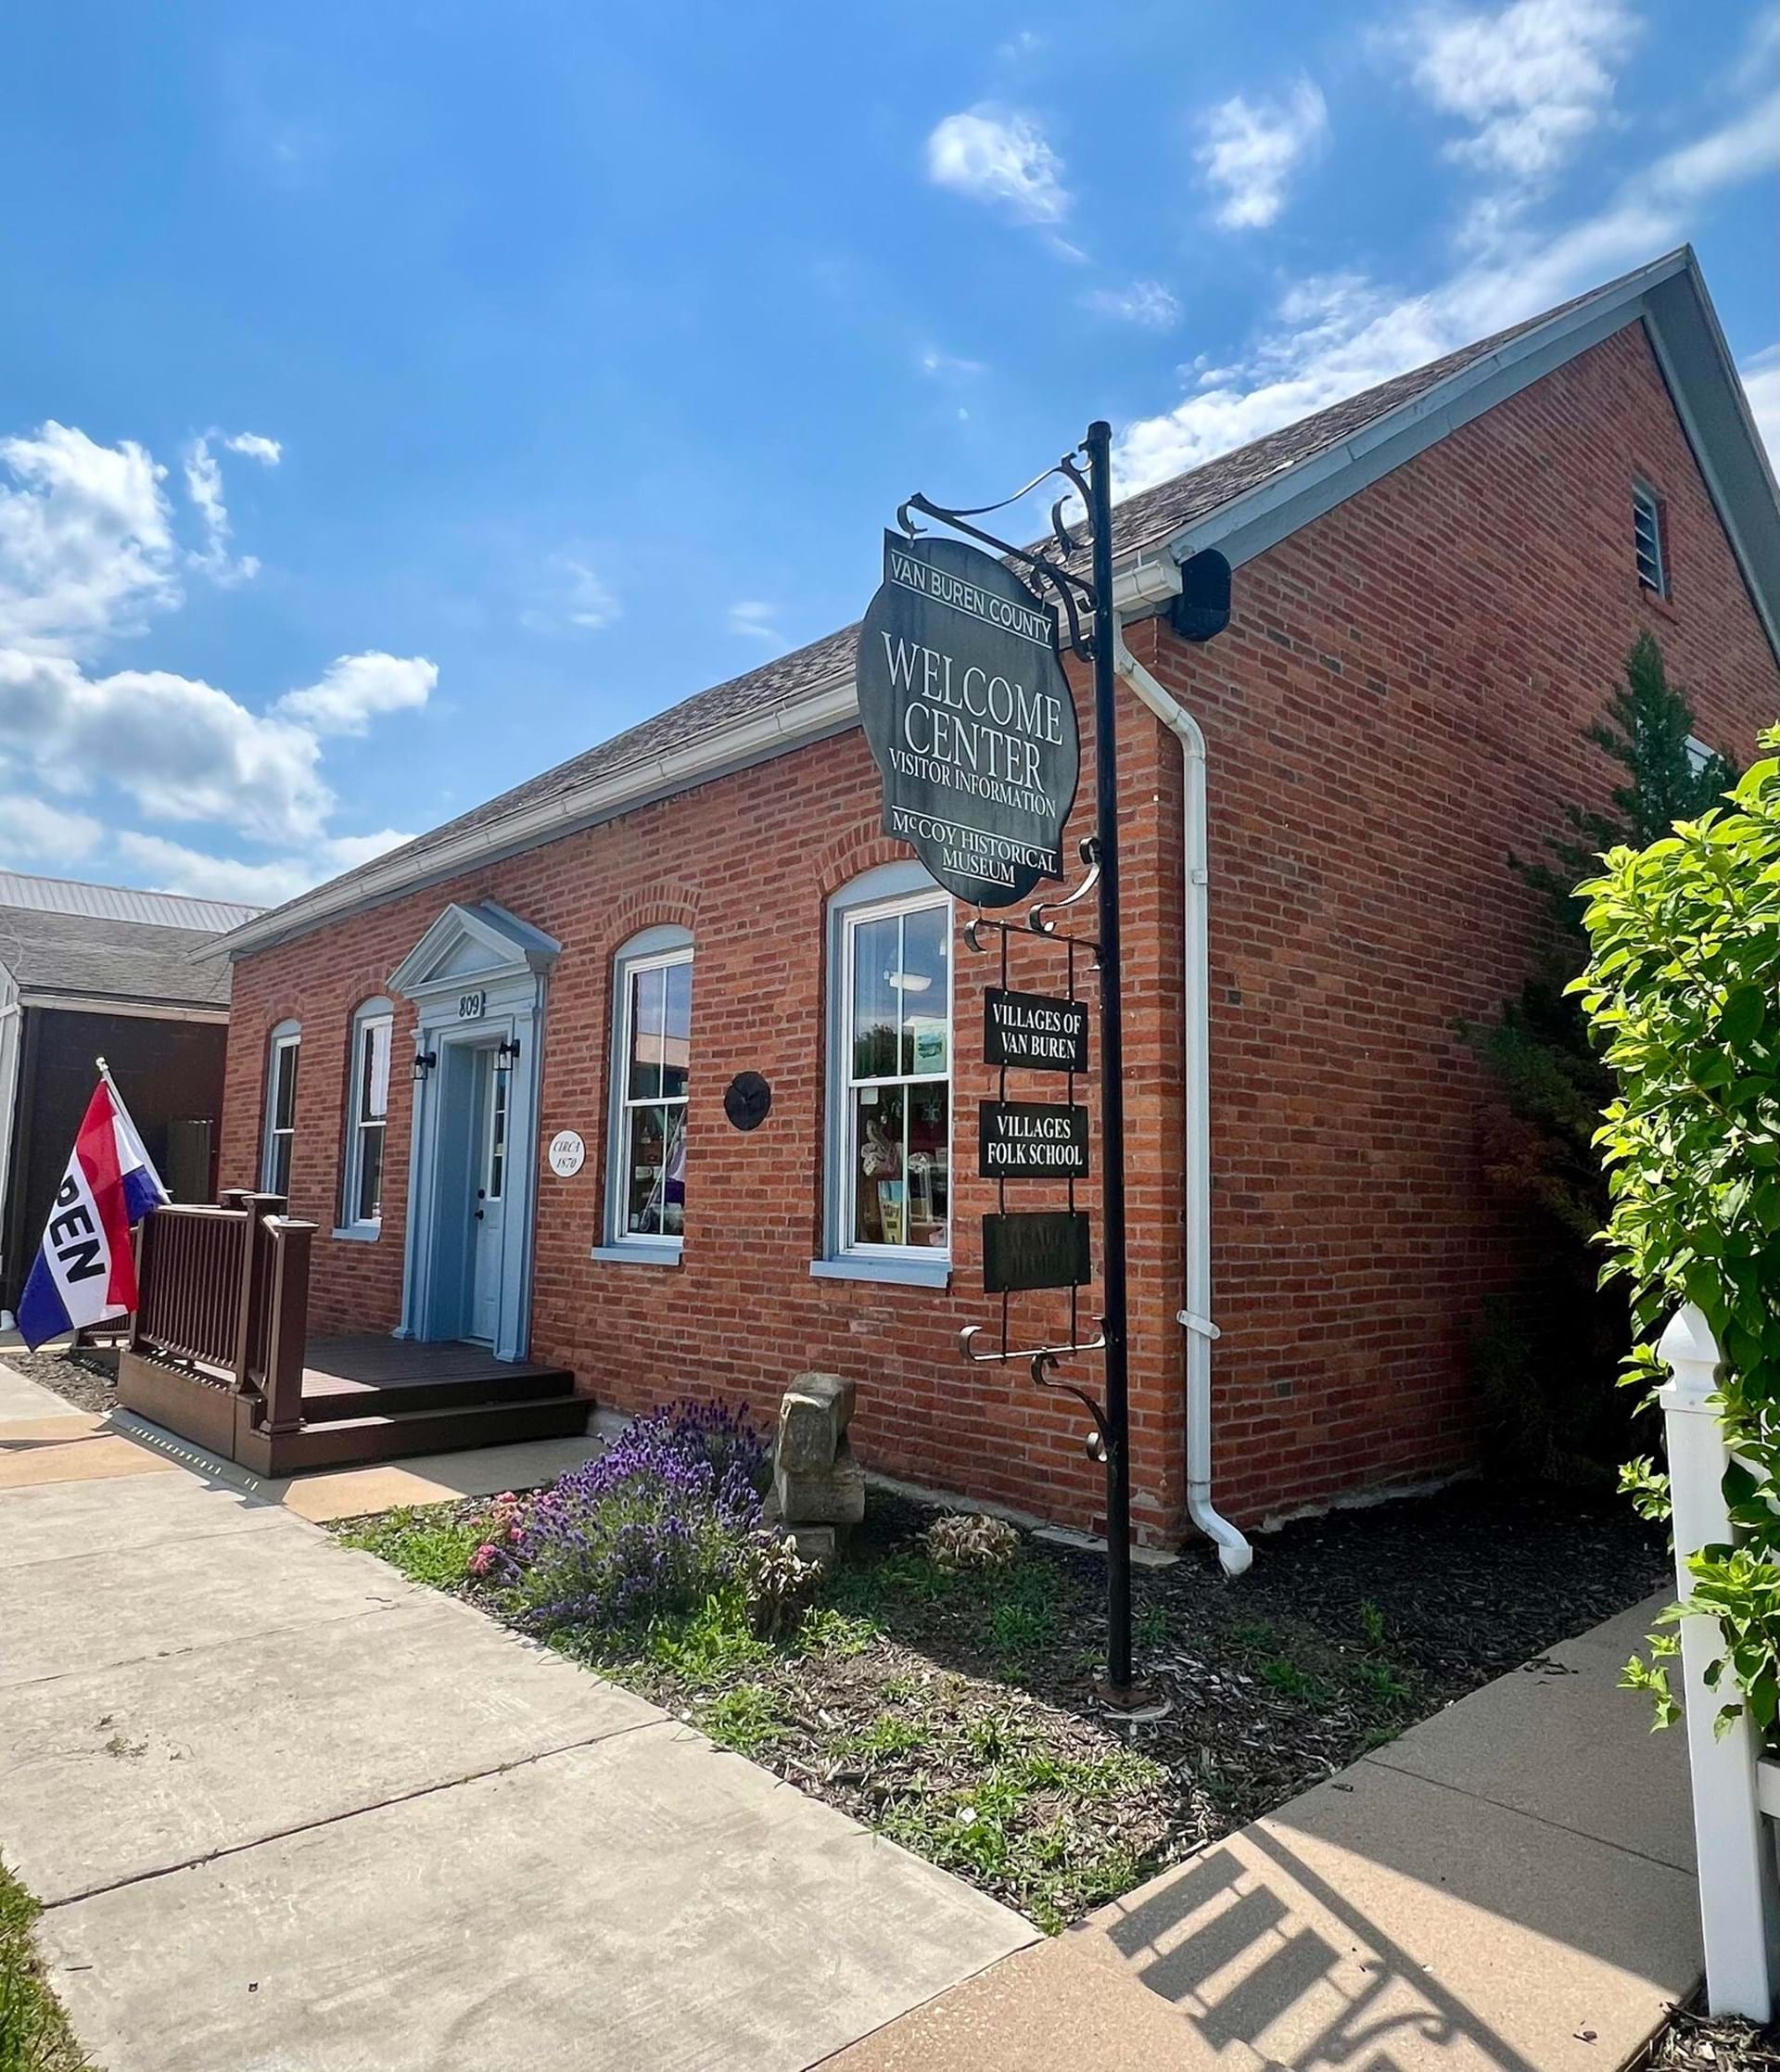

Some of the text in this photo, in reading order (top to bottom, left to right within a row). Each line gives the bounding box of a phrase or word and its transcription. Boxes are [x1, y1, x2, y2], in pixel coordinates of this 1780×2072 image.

[891, 553, 1052, 643] VAN BUREN COUNTY
[881, 631, 1063, 746] WELCOME
[904, 702, 1045, 793] CENTER
[889, 747, 1056, 819] VISITOR INFORMATION
[942, 846, 1015, 884] MUSEUM
[960, 831, 1057, 873] HISTORICAL
[459, 995, 479, 1017] 809
[993, 1003, 1082, 1035] VILLAGES OF
[1001, 1031, 1075, 1059] VAN BUREN
[997, 1115, 1071, 1138] VILLAGES
[556, 1157, 577, 1168] 1870
[987, 1143, 1083, 1165] FOLK SCHOOL
